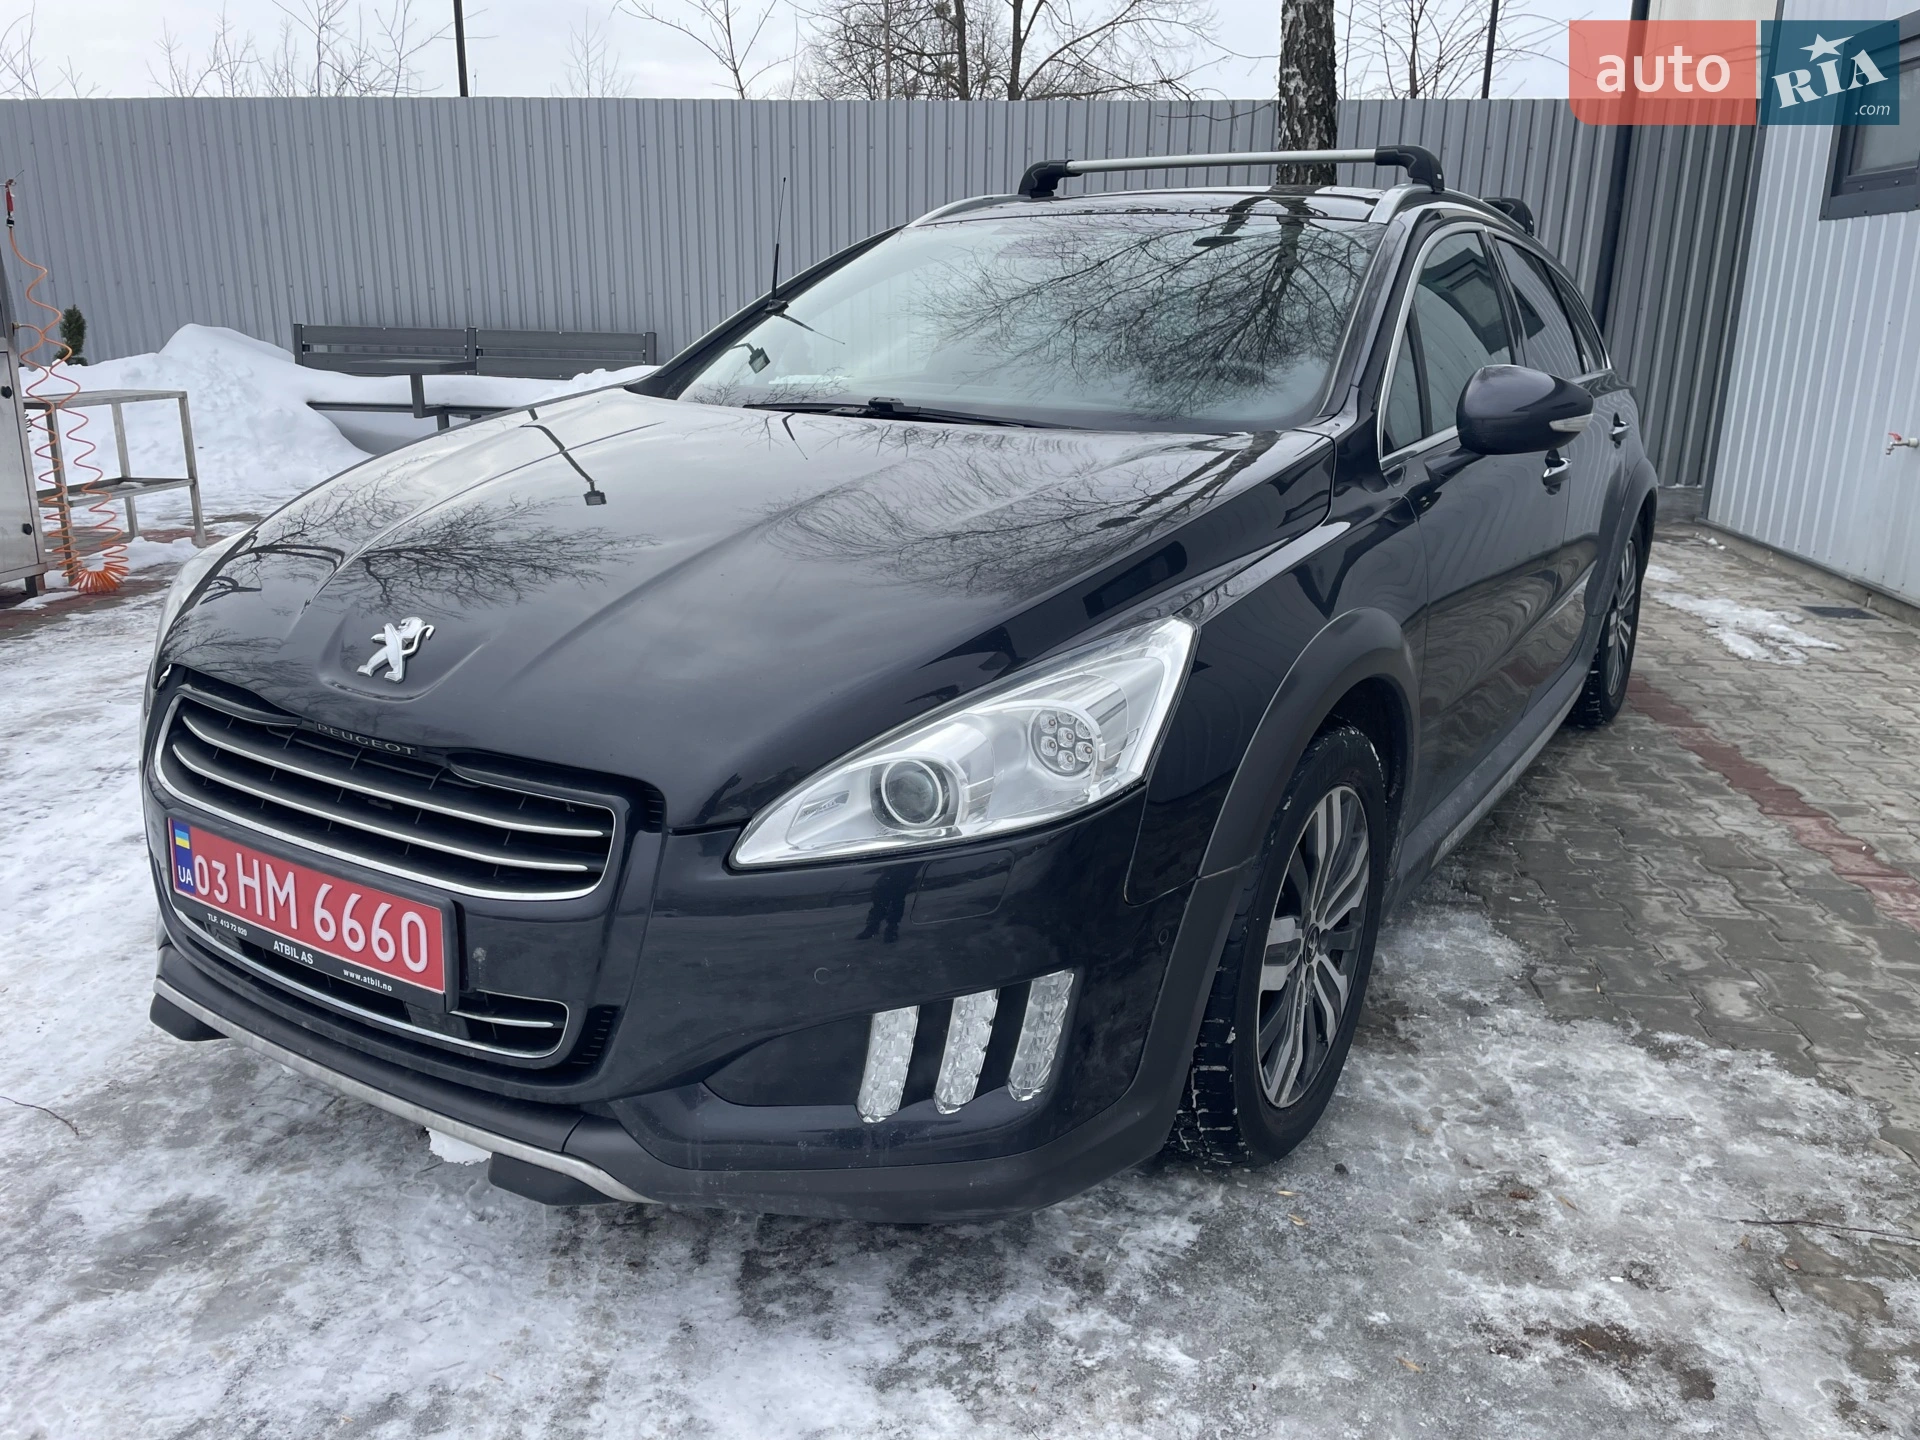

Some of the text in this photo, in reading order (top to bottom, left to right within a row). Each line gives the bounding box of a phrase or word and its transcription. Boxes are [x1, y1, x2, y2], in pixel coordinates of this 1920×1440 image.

[317, 723, 416, 755] PEUGEOT
[178, 865, 193, 887] UA
[194, 852, 428, 973] 03 HM 6660
[230, 923, 237, 932] 72
[273, 940, 314, 965] ATBIL AS
[343, 969, 393, 992] www.atbil.no
